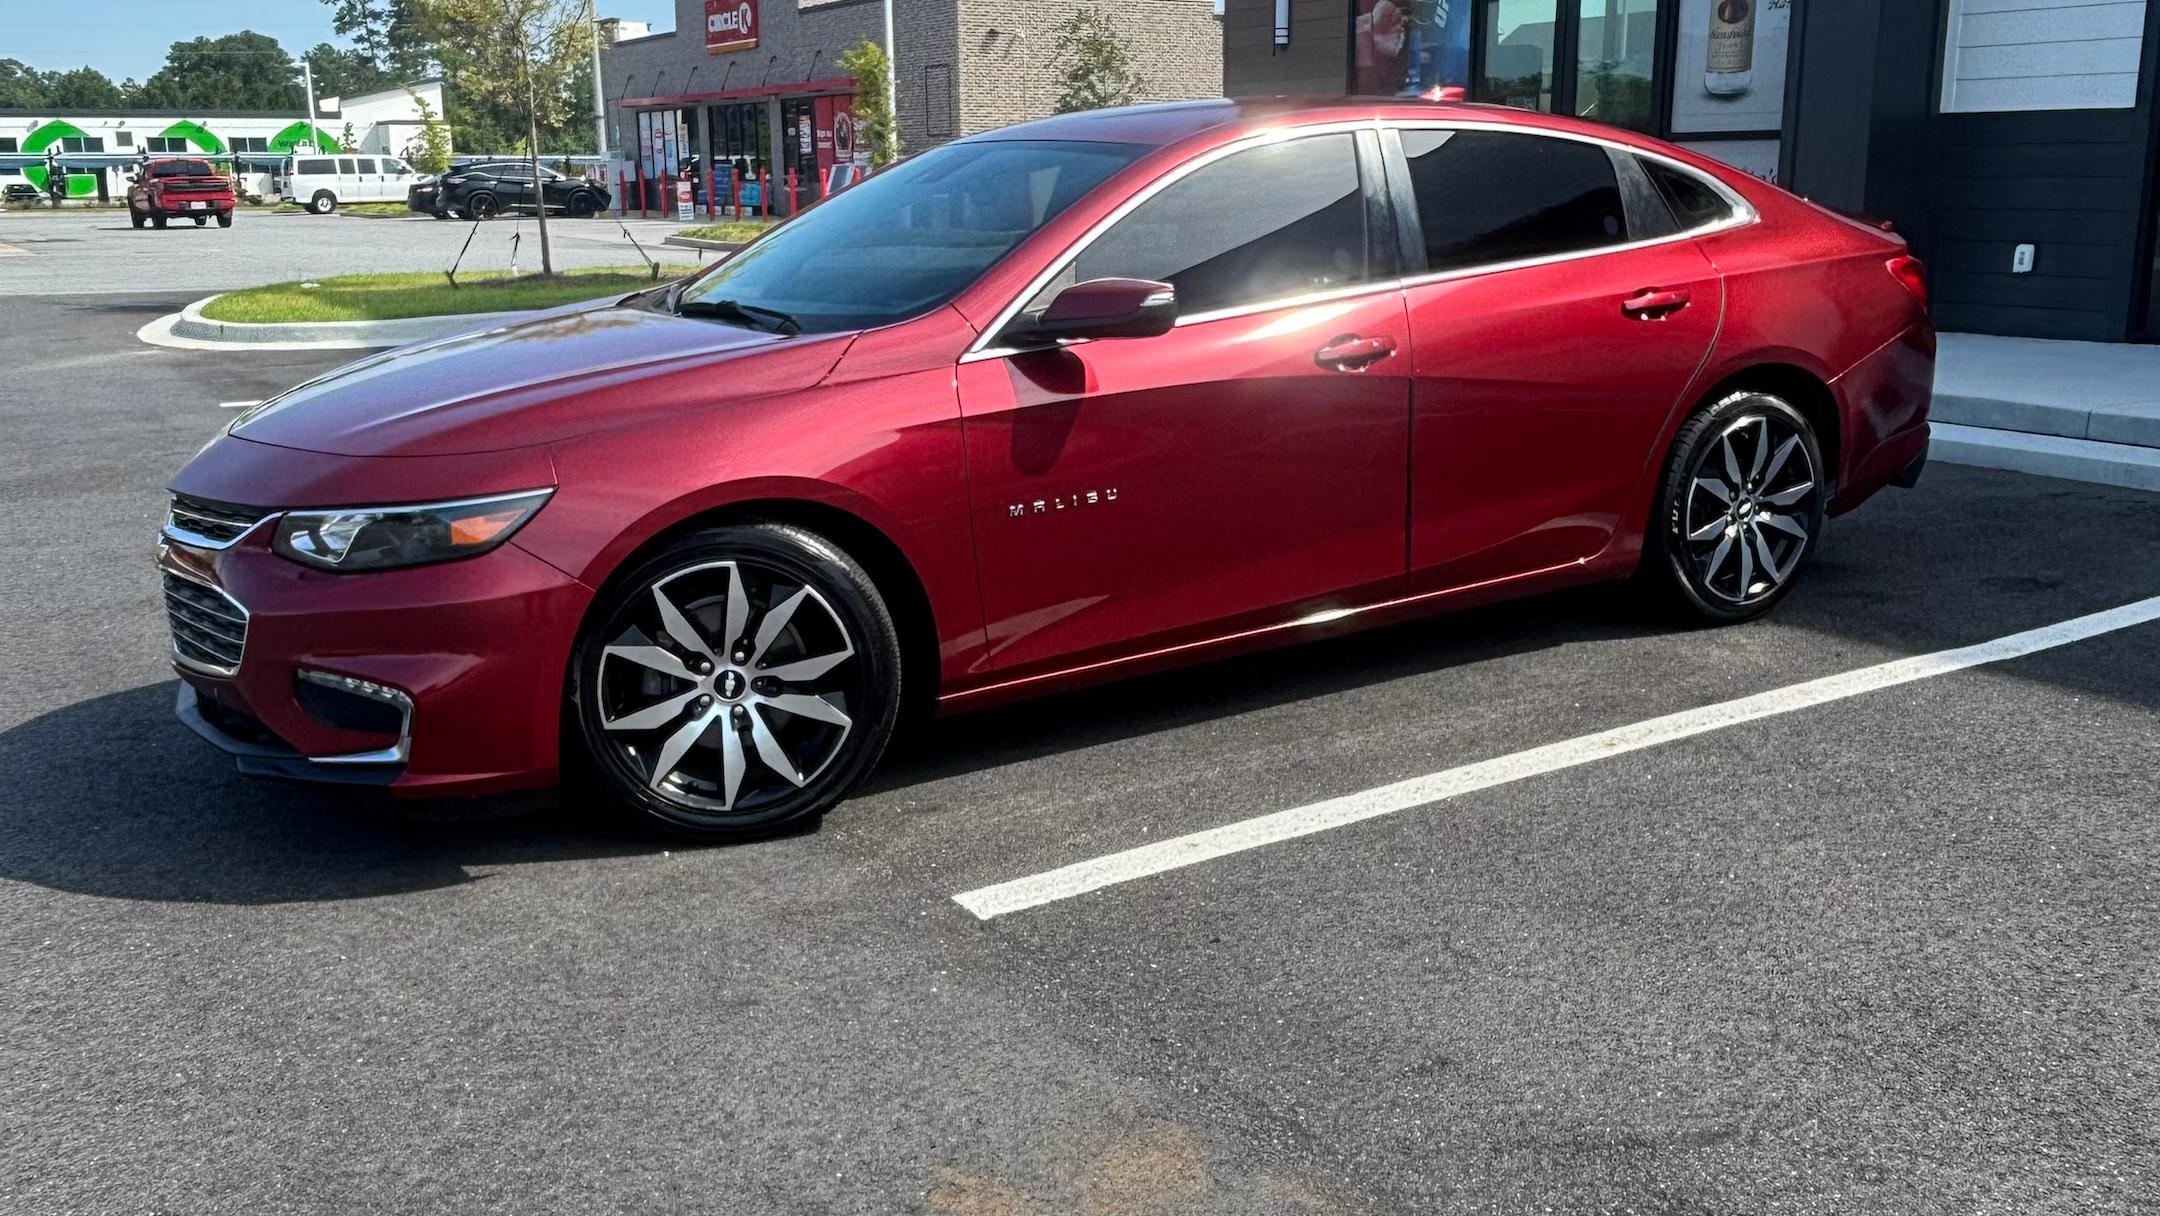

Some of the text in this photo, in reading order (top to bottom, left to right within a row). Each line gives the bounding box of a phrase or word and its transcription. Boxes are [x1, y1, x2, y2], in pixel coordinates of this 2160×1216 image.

[708, 4, 751, 32] CIRCLE K
[1009, 488, 1118, 517] MALIBU
